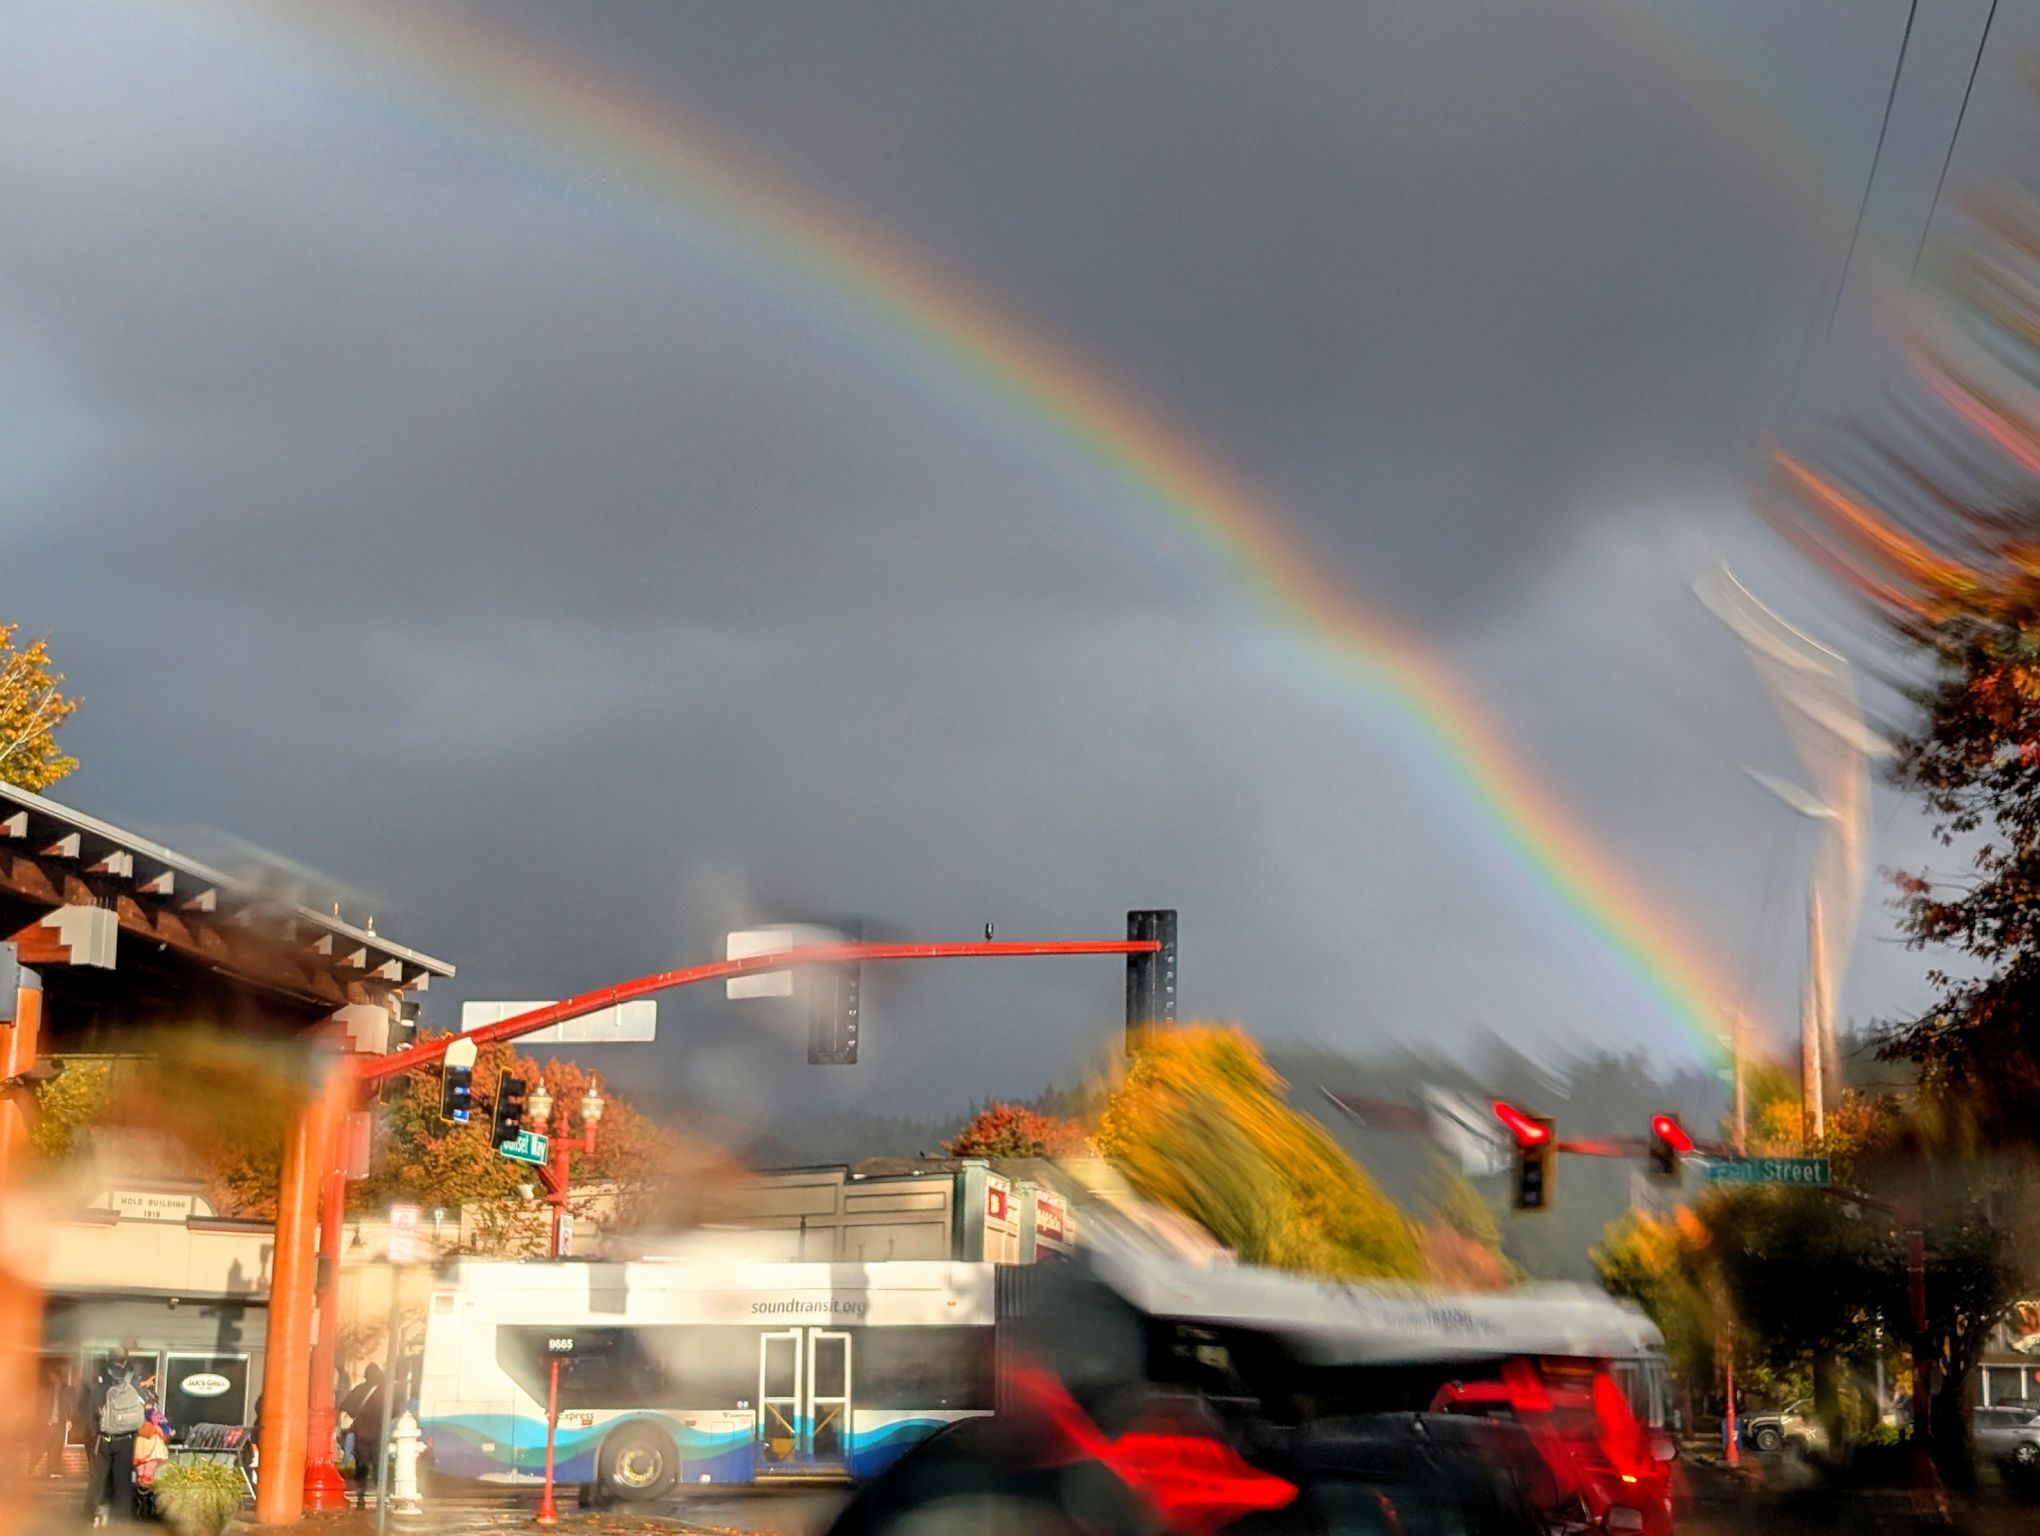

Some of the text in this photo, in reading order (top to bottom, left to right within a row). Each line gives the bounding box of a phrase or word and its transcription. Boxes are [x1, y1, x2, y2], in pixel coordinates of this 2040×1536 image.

[531, 1135, 546, 1162] Way
[1763, 1160, 1820, 1181] Street
[121, 1197, 186, 1209] WOLD BUILDING
[751, 1298, 867, 1319] soundtransit.org
[548, 1339, 573, 1351] 9665
